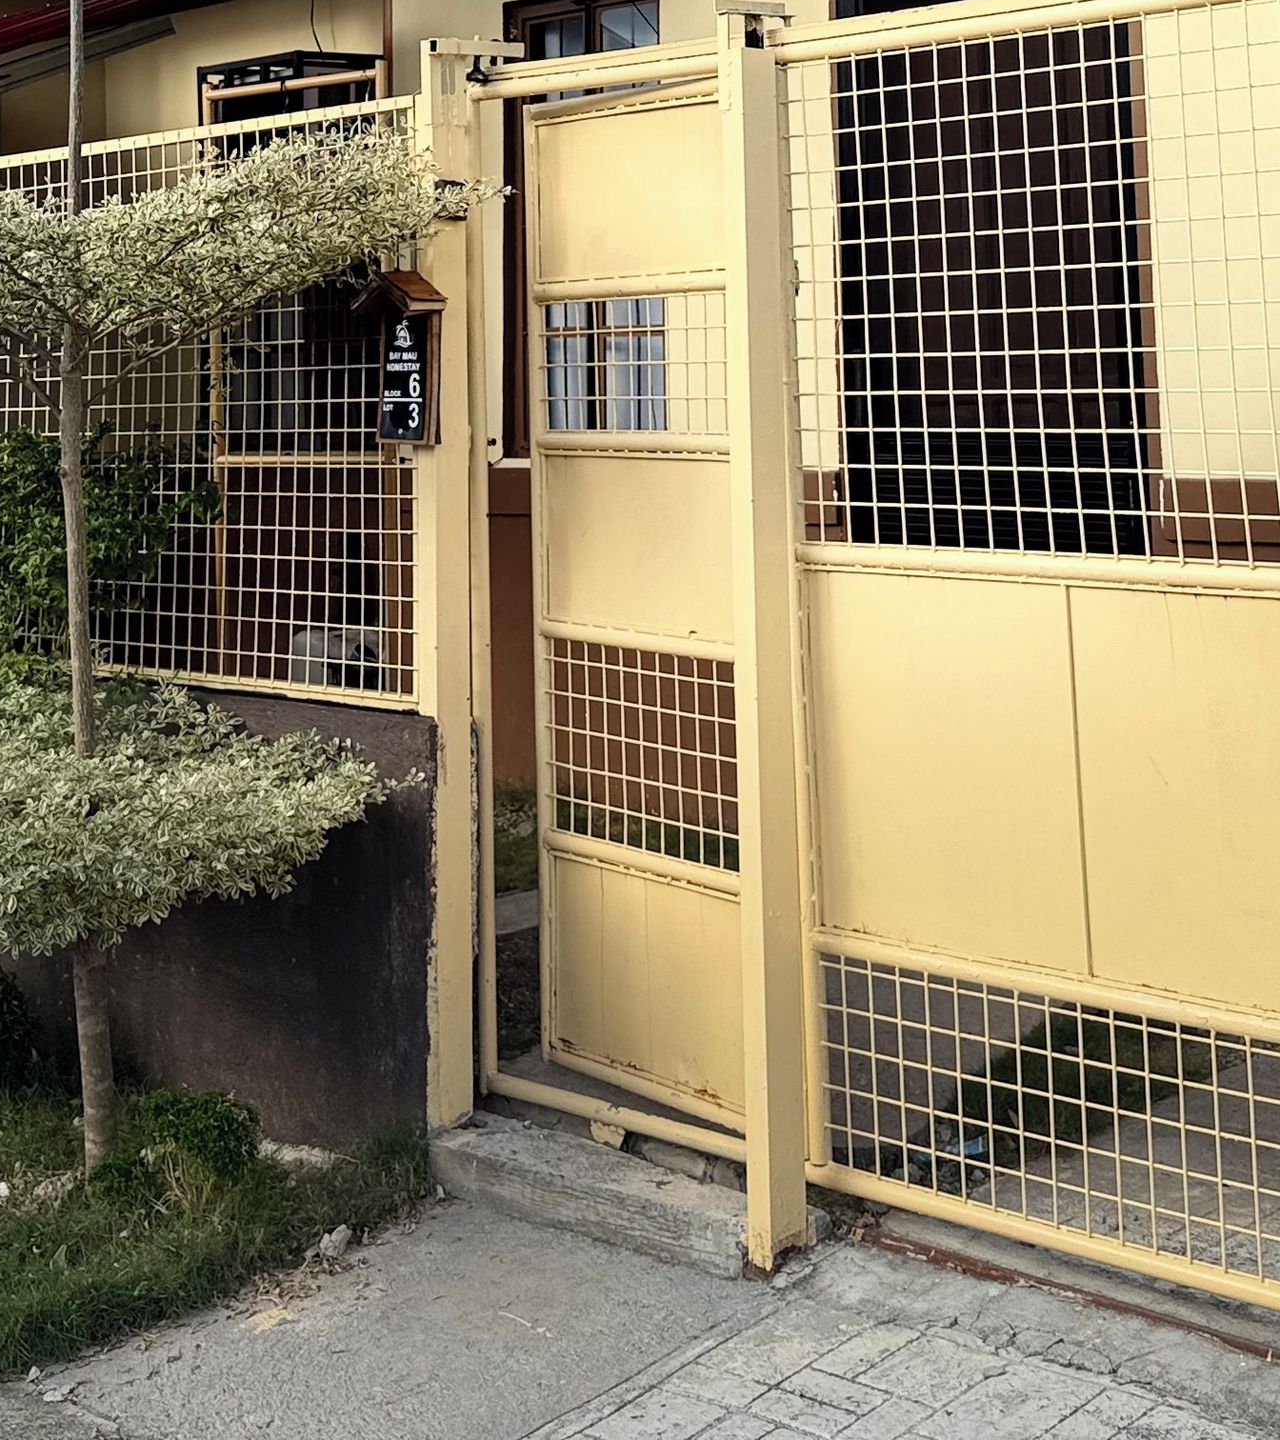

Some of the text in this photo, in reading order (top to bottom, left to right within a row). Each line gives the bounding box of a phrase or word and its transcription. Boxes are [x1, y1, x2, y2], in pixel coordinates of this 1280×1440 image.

[386, 362, 420, 371] HOMESTAY
[409, 373, 420, 398] 6
[383, 403, 419, 428] LOT 3
